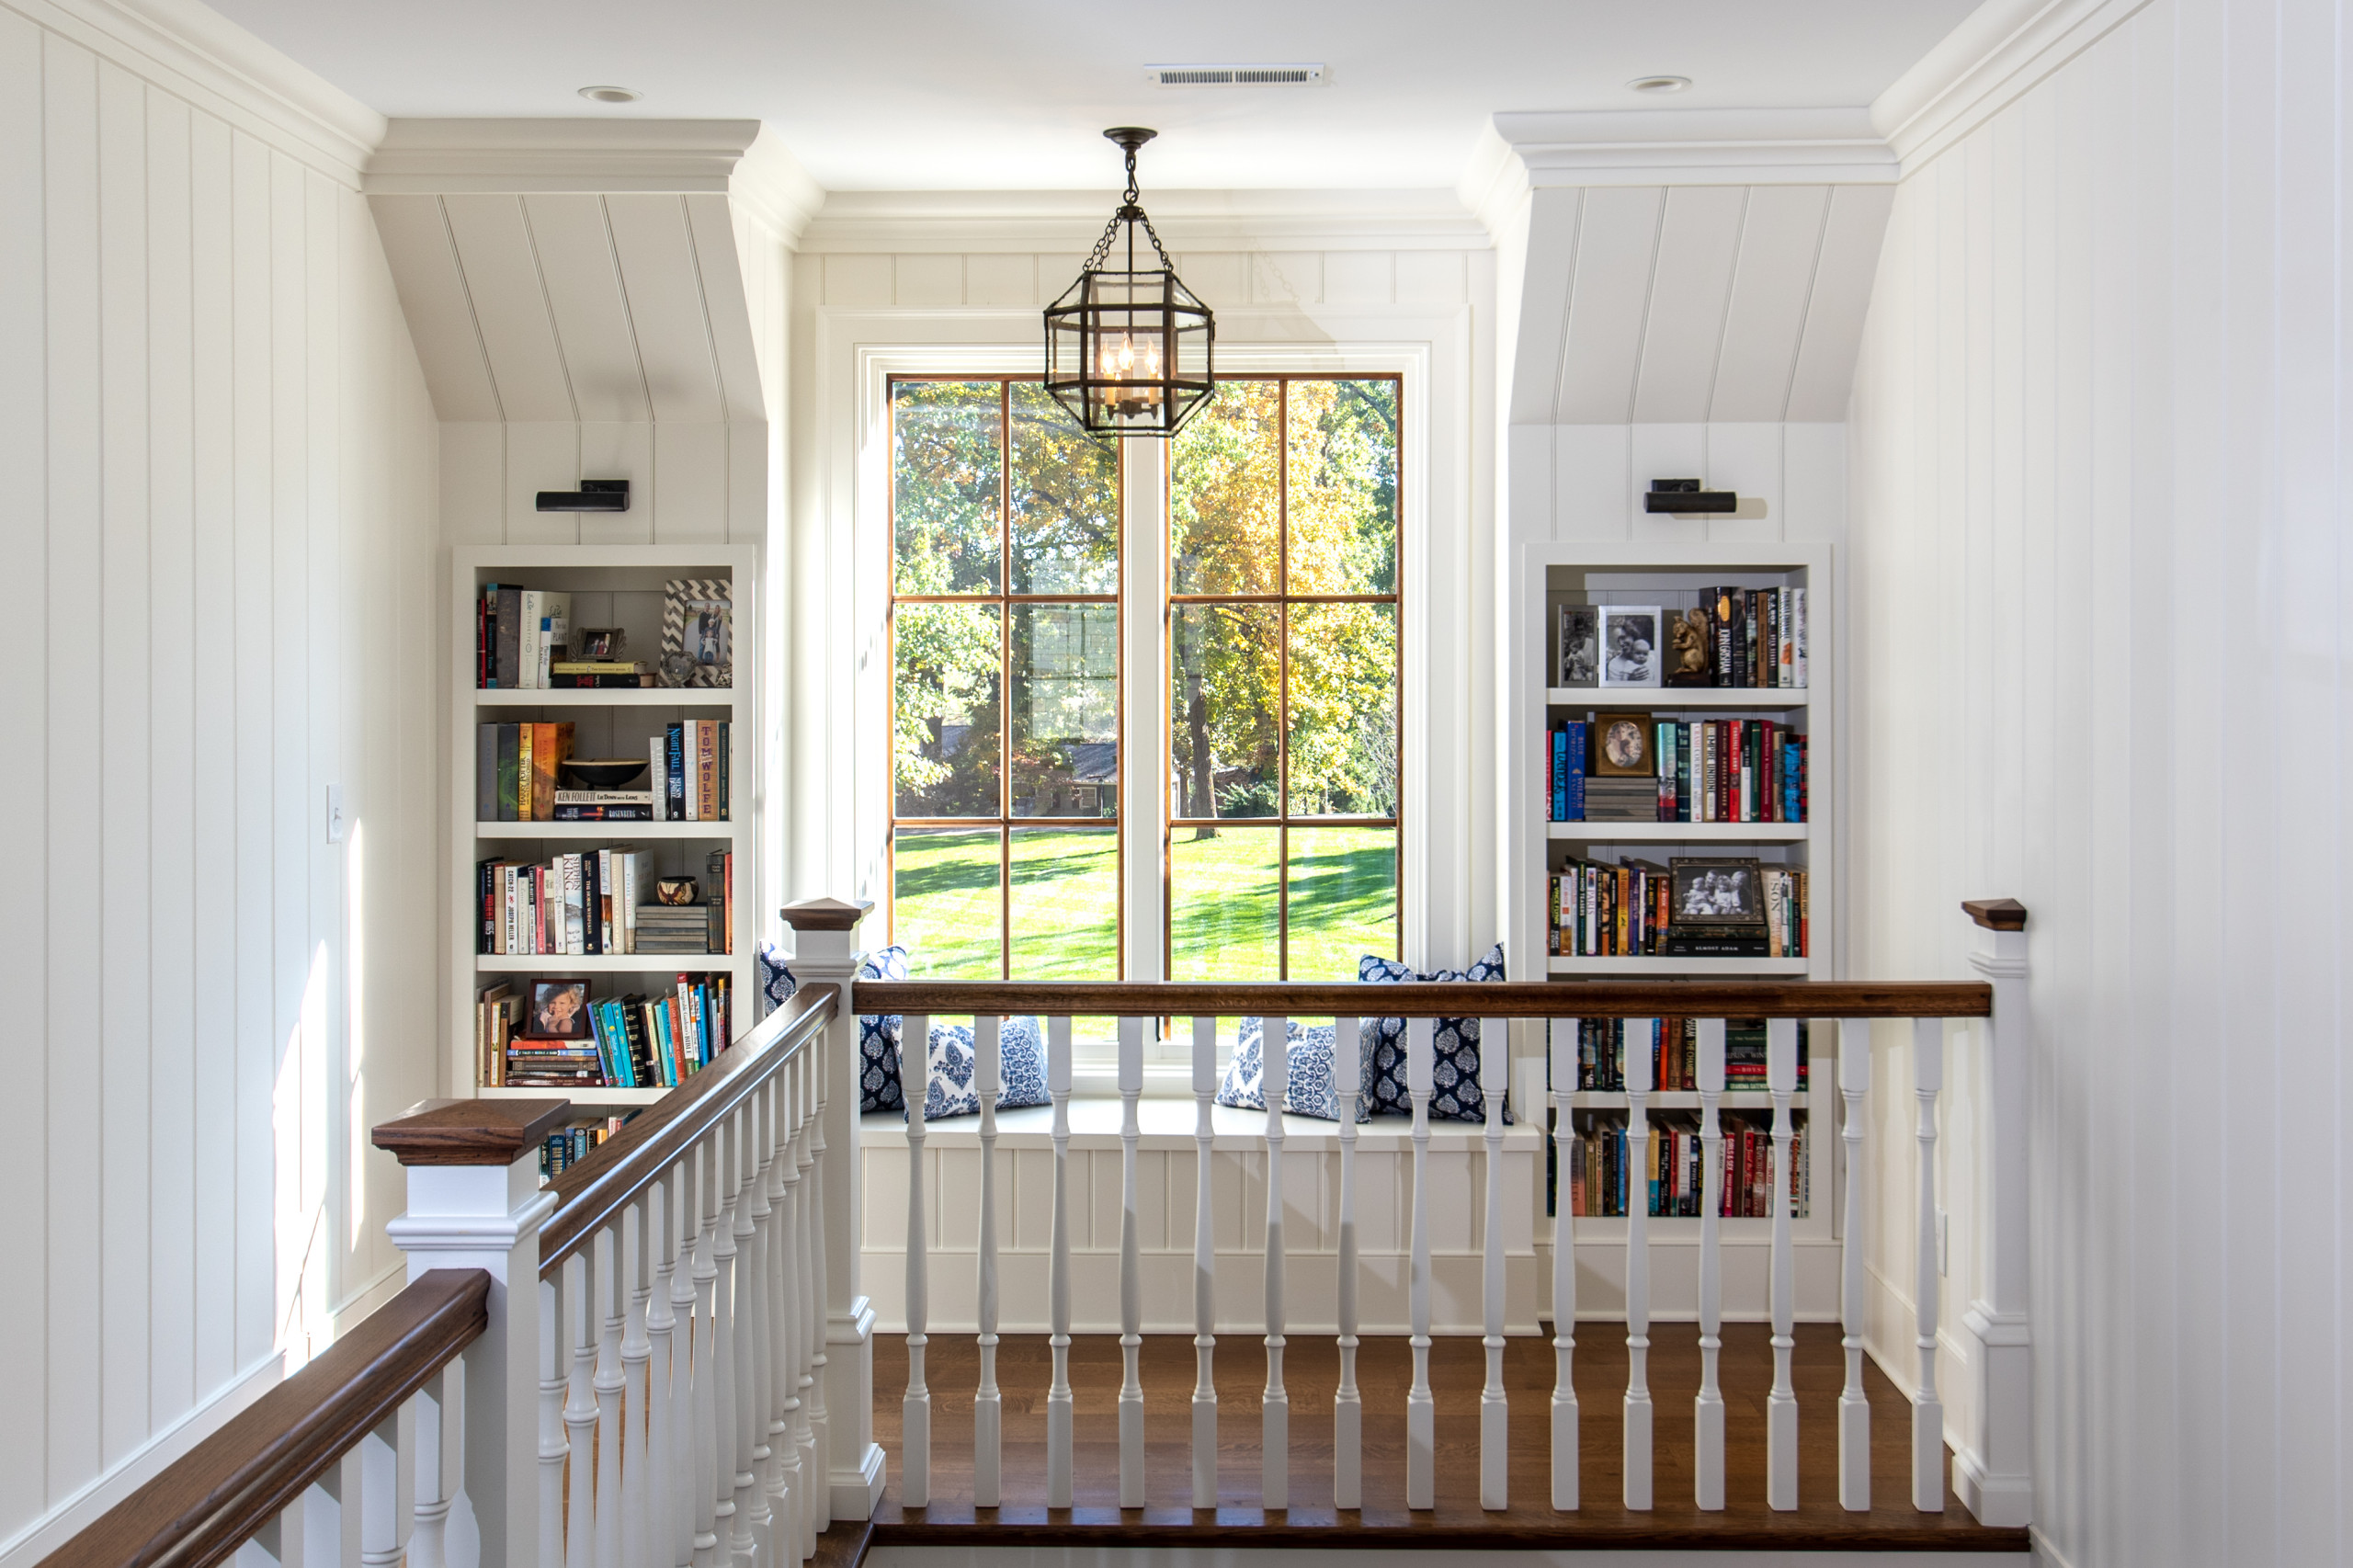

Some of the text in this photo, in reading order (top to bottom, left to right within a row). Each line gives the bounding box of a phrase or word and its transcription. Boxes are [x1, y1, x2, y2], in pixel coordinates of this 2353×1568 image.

[1720, 630, 1731, 675] JOHN GRISHAM
[1707, 735, 1716, 761] EMPIRE
[1707, 764, 1716, 795] UNDONE
[558, 791, 597, 802] KEN FOLLETT
[609, 810, 636, 819] ROSENBERG
[564, 857, 574, 891] KING
[573, 857, 581, 891] STEPHEN
[1771, 882, 1780, 912] SON
[485, 921, 494, 935] 1065
[684, 1036, 692, 1055] BIBLE
[1686, 1040, 1694, 1051] THE
[1686, 1051, 1694, 1076] CHAMBER
[551, 1147, 563, 1159] DAN
[1726, 1138, 1734, 1154] GIRLS
